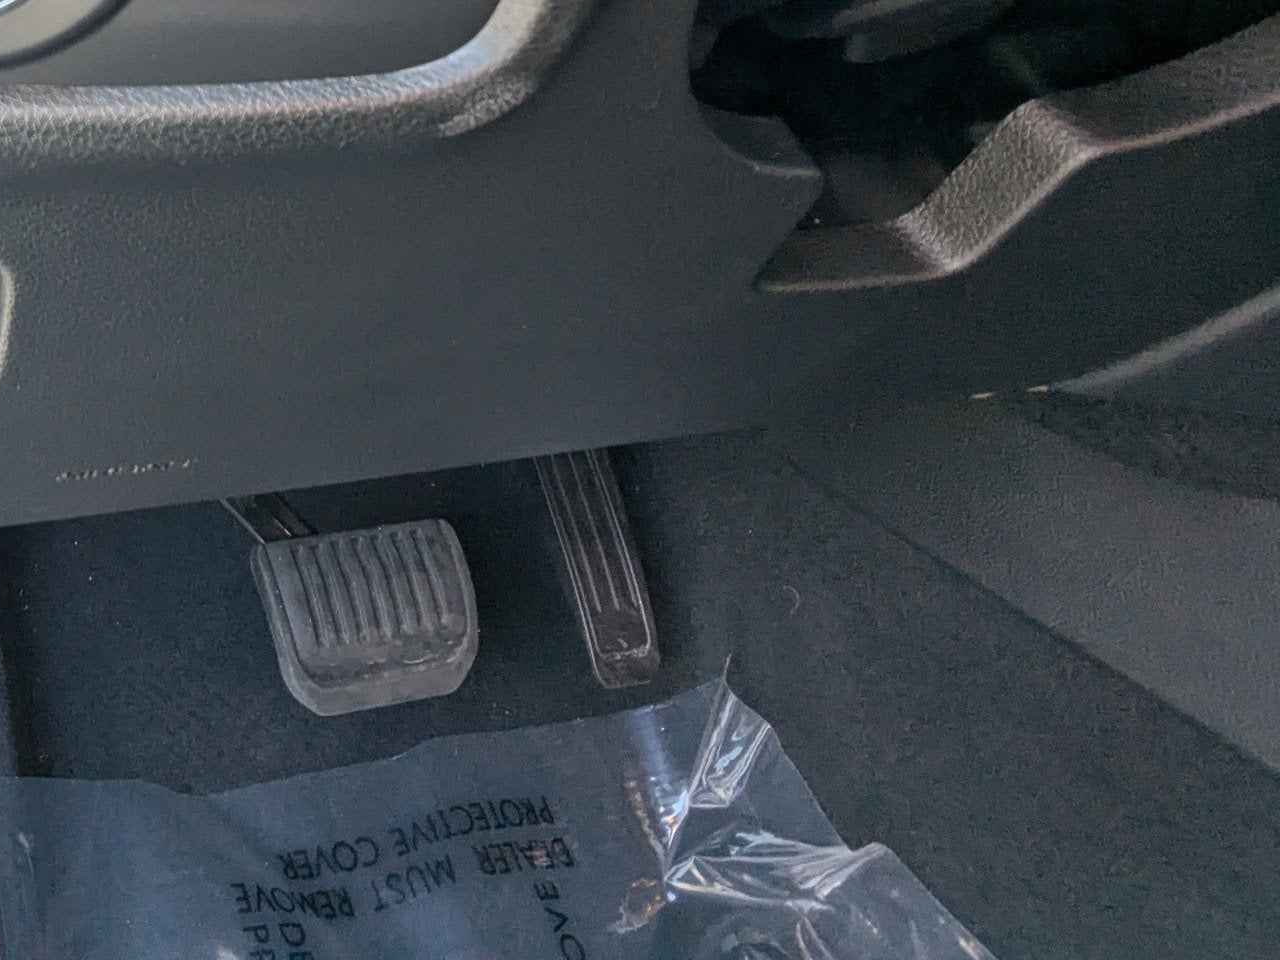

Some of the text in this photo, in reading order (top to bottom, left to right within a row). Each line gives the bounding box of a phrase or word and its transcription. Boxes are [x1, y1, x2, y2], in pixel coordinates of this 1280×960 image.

[231, 837, 575, 920] DEALER MUST REMOVE
[279, 795, 556, 881] PROTECTIVE COVER
